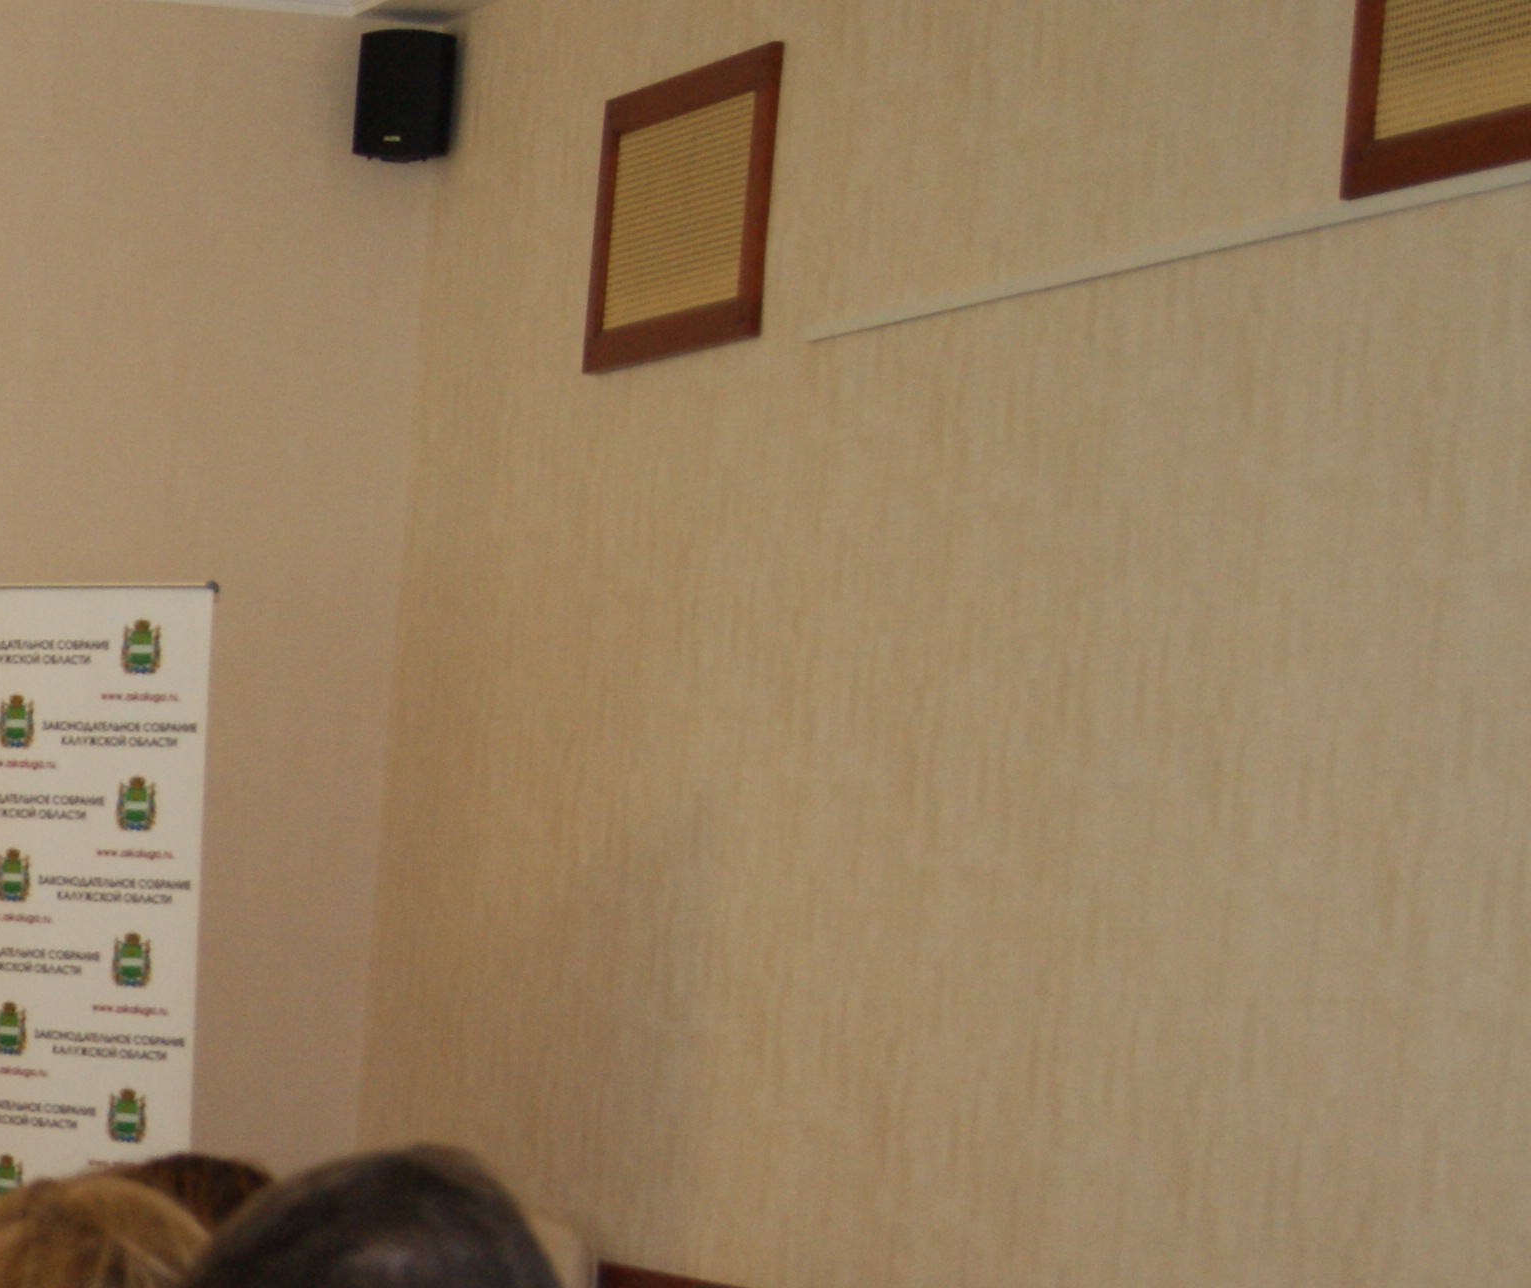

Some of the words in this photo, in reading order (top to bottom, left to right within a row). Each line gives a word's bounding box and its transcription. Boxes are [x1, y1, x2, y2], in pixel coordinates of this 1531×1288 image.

[57, 639, 109, 650] СОБРАНИЕ
[42, 654, 91, 665] ОБЛАСТИ
[42, 720, 141, 733] ЗАКОНОДАТЕЛЬНОЕ
[143, 722, 197, 733] СОБРАНИЕ
[61, 735, 127, 747] КАЛУЖСКОЙ
[128, 736, 178, 748] ОБЛАСТИ
[53, 795, 105, 806] СОБРАНИЕ
[39, 809, 86, 820] ОБЛАСТИ
[38, 875, 136, 889] ЗАКОНОДАТЕЛЬНОЕ
[140, 878, 191, 891] СОБРАНИЕ
[56, 891, 121, 903] КАЛУЖСКОЙ
[124, 893, 173, 904] ОБЛАСТИ
[48, 949, 100, 962] СОБРАНИЕ
[36, 963, 82, 975] ОБЛАСТИ
[34, 1029, 131, 1045] ЗАКОНОДАТЕЛЬНОЕ
[134, 1035, 185, 1048] СОБРАНИЕ
[52, 1045, 119, 1059] КАЛУЖСКОЙ
[120, 1049, 167, 1061] ОБЛАСТИ
[44, 1103, 96, 1117] СОБРАНИЕ
[31, 1116, 78, 1130] ОБЛАСТИ
